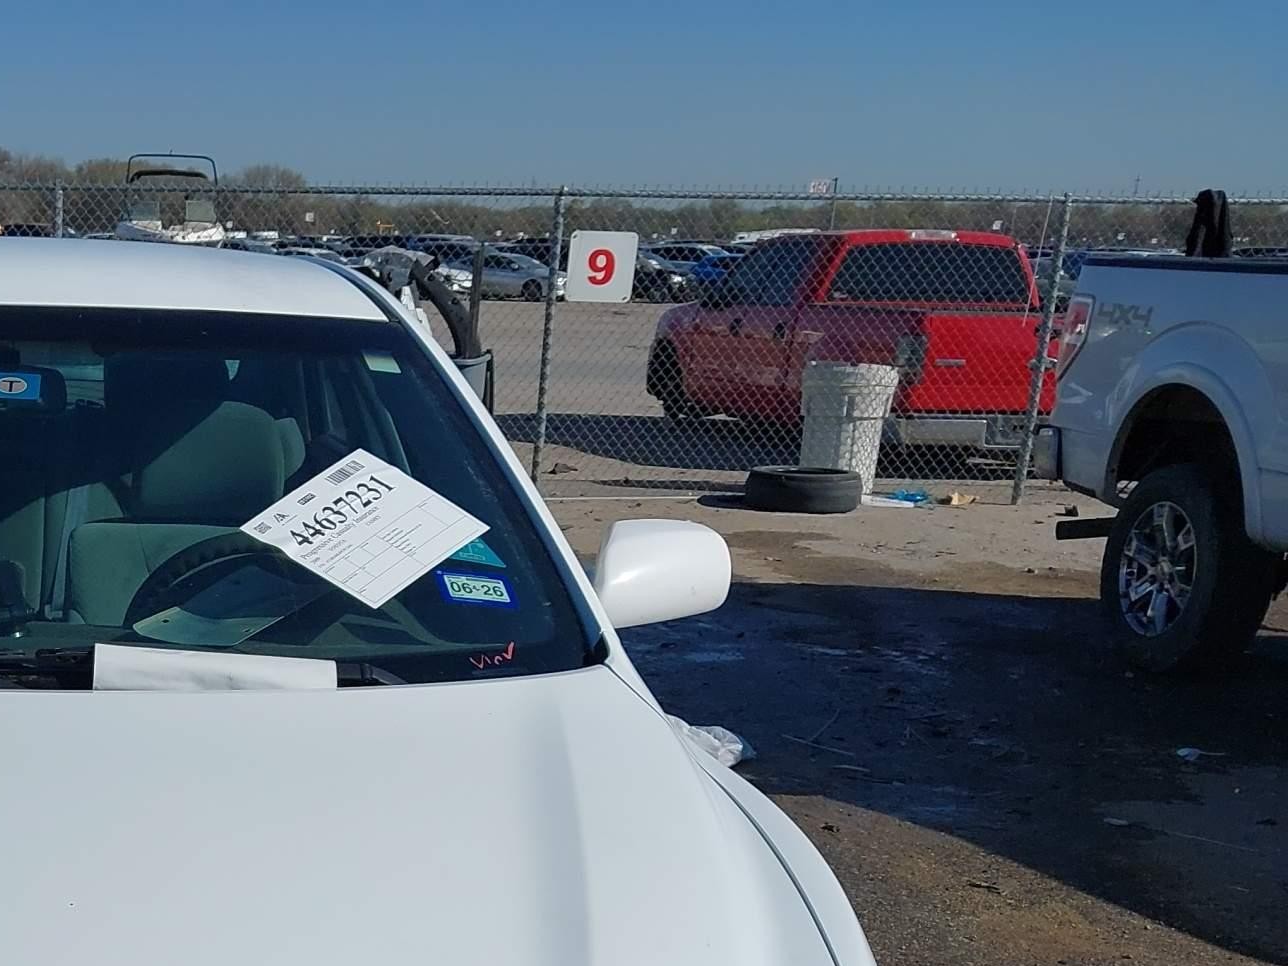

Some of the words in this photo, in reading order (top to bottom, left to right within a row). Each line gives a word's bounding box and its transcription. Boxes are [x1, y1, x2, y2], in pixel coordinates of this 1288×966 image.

[588, 248, 616, 285] 9
[2, 380, 21, 392] T
[290, 475, 396, 546] 44637231
[450, 581, 473, 594] 06
[480, 584, 504, 597] 26
